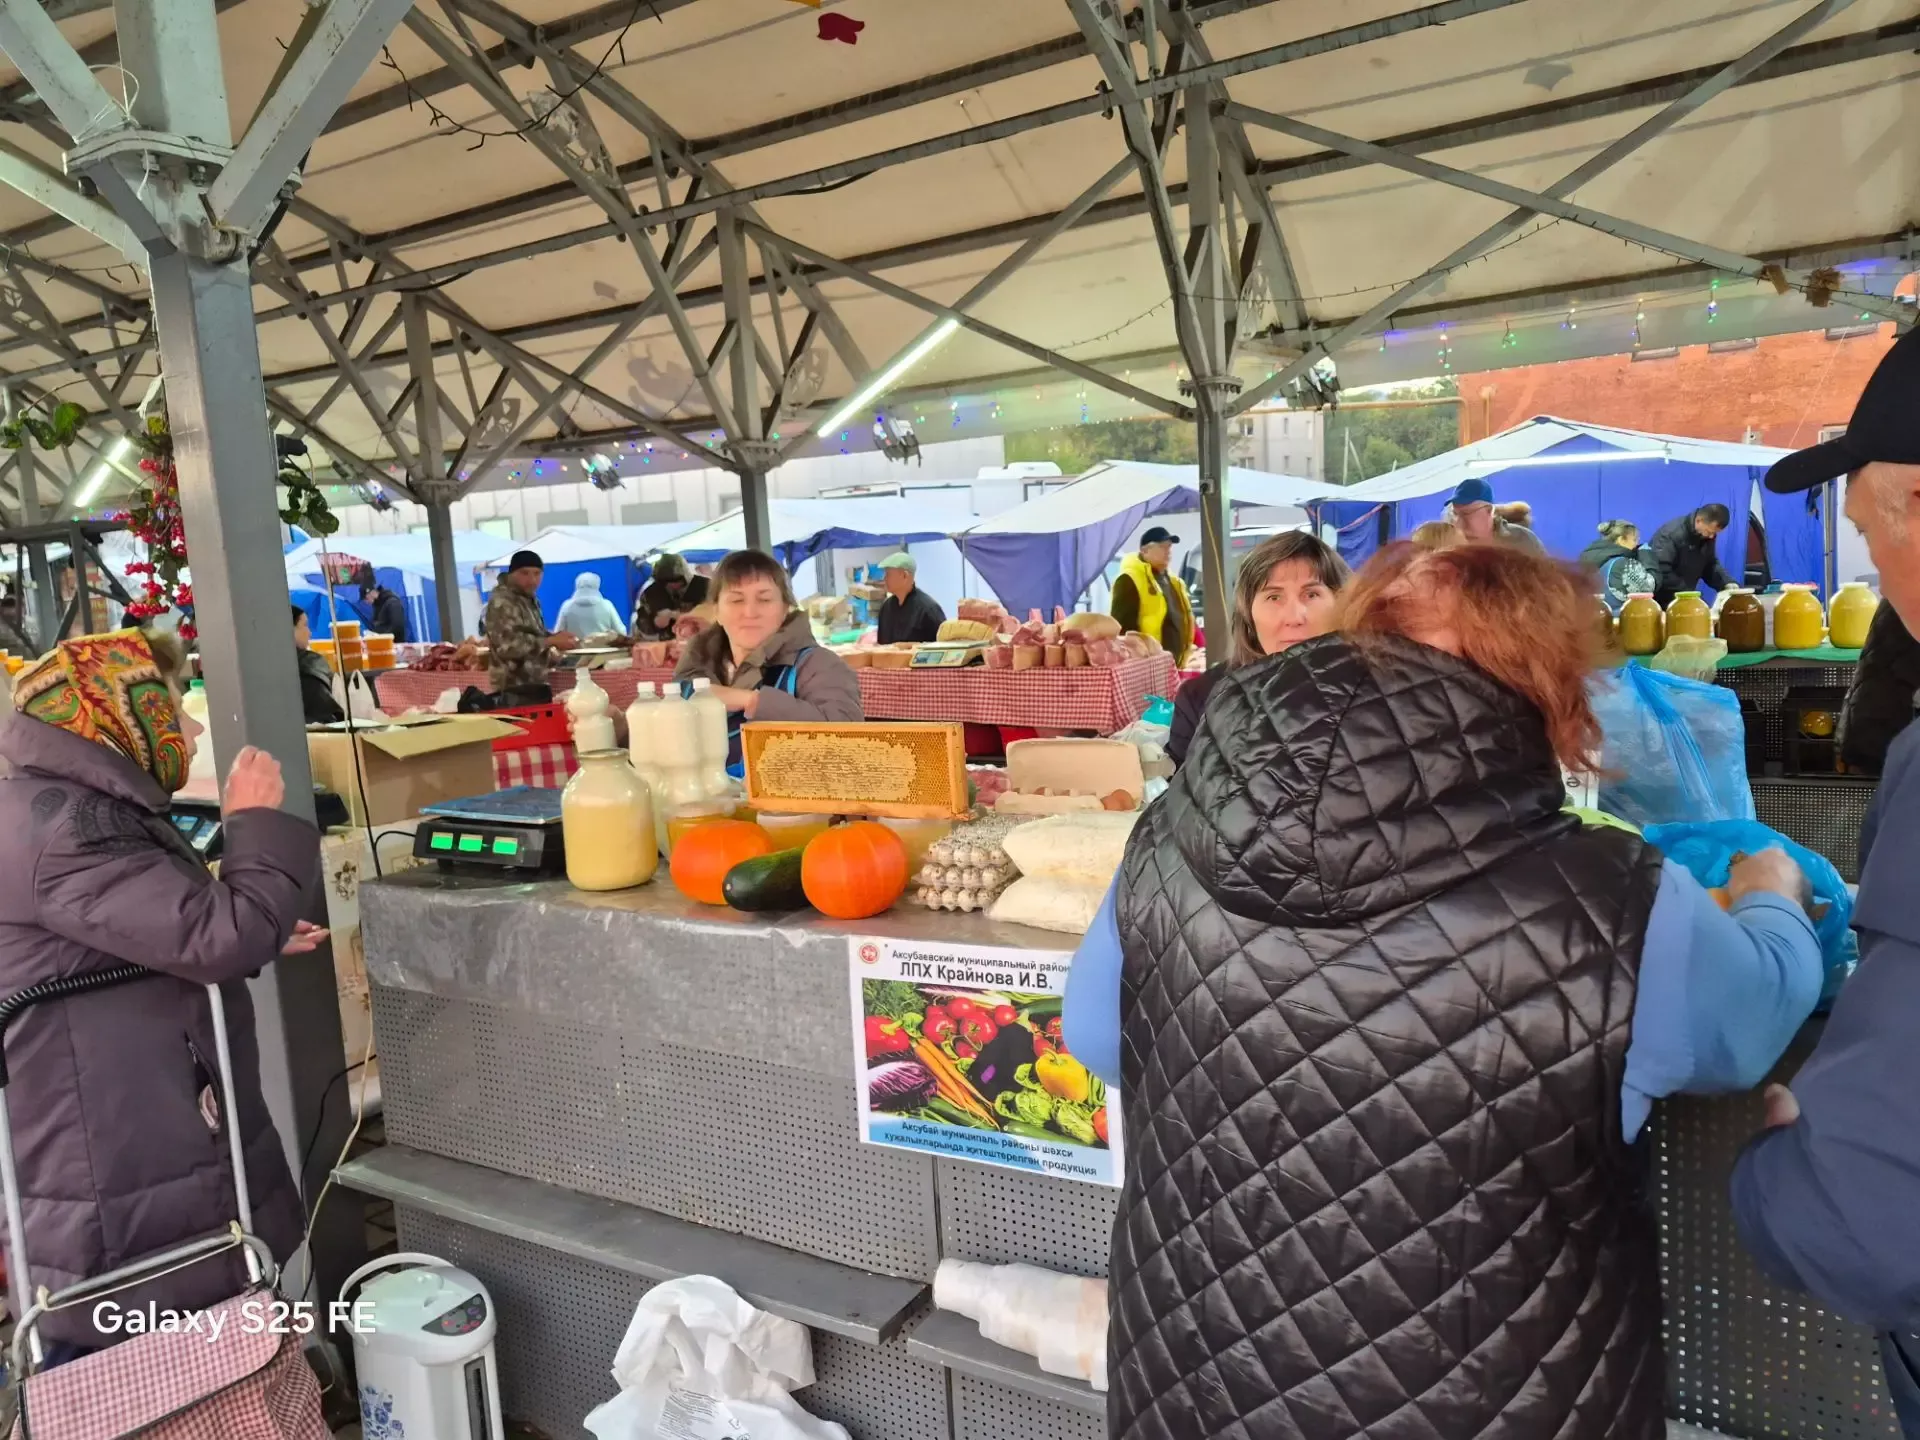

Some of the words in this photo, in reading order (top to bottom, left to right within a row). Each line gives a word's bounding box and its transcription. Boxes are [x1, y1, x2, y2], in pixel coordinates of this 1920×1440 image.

[892, 949, 955, 963] Аксубаевский
[957, 957, 1037, 971] муниципальный
[900, 961, 933, 979] ЛПХ
[937, 965, 1014, 988] Крайнова
[1019, 971, 1053, 990] И.В.
[901, 1121, 939, 1137] Аксубай
[941, 1127, 1000, 1146] муниципаль
[1001, 1138, 1040, 1154] районы
[1042, 1158, 1098, 1177] продукция
